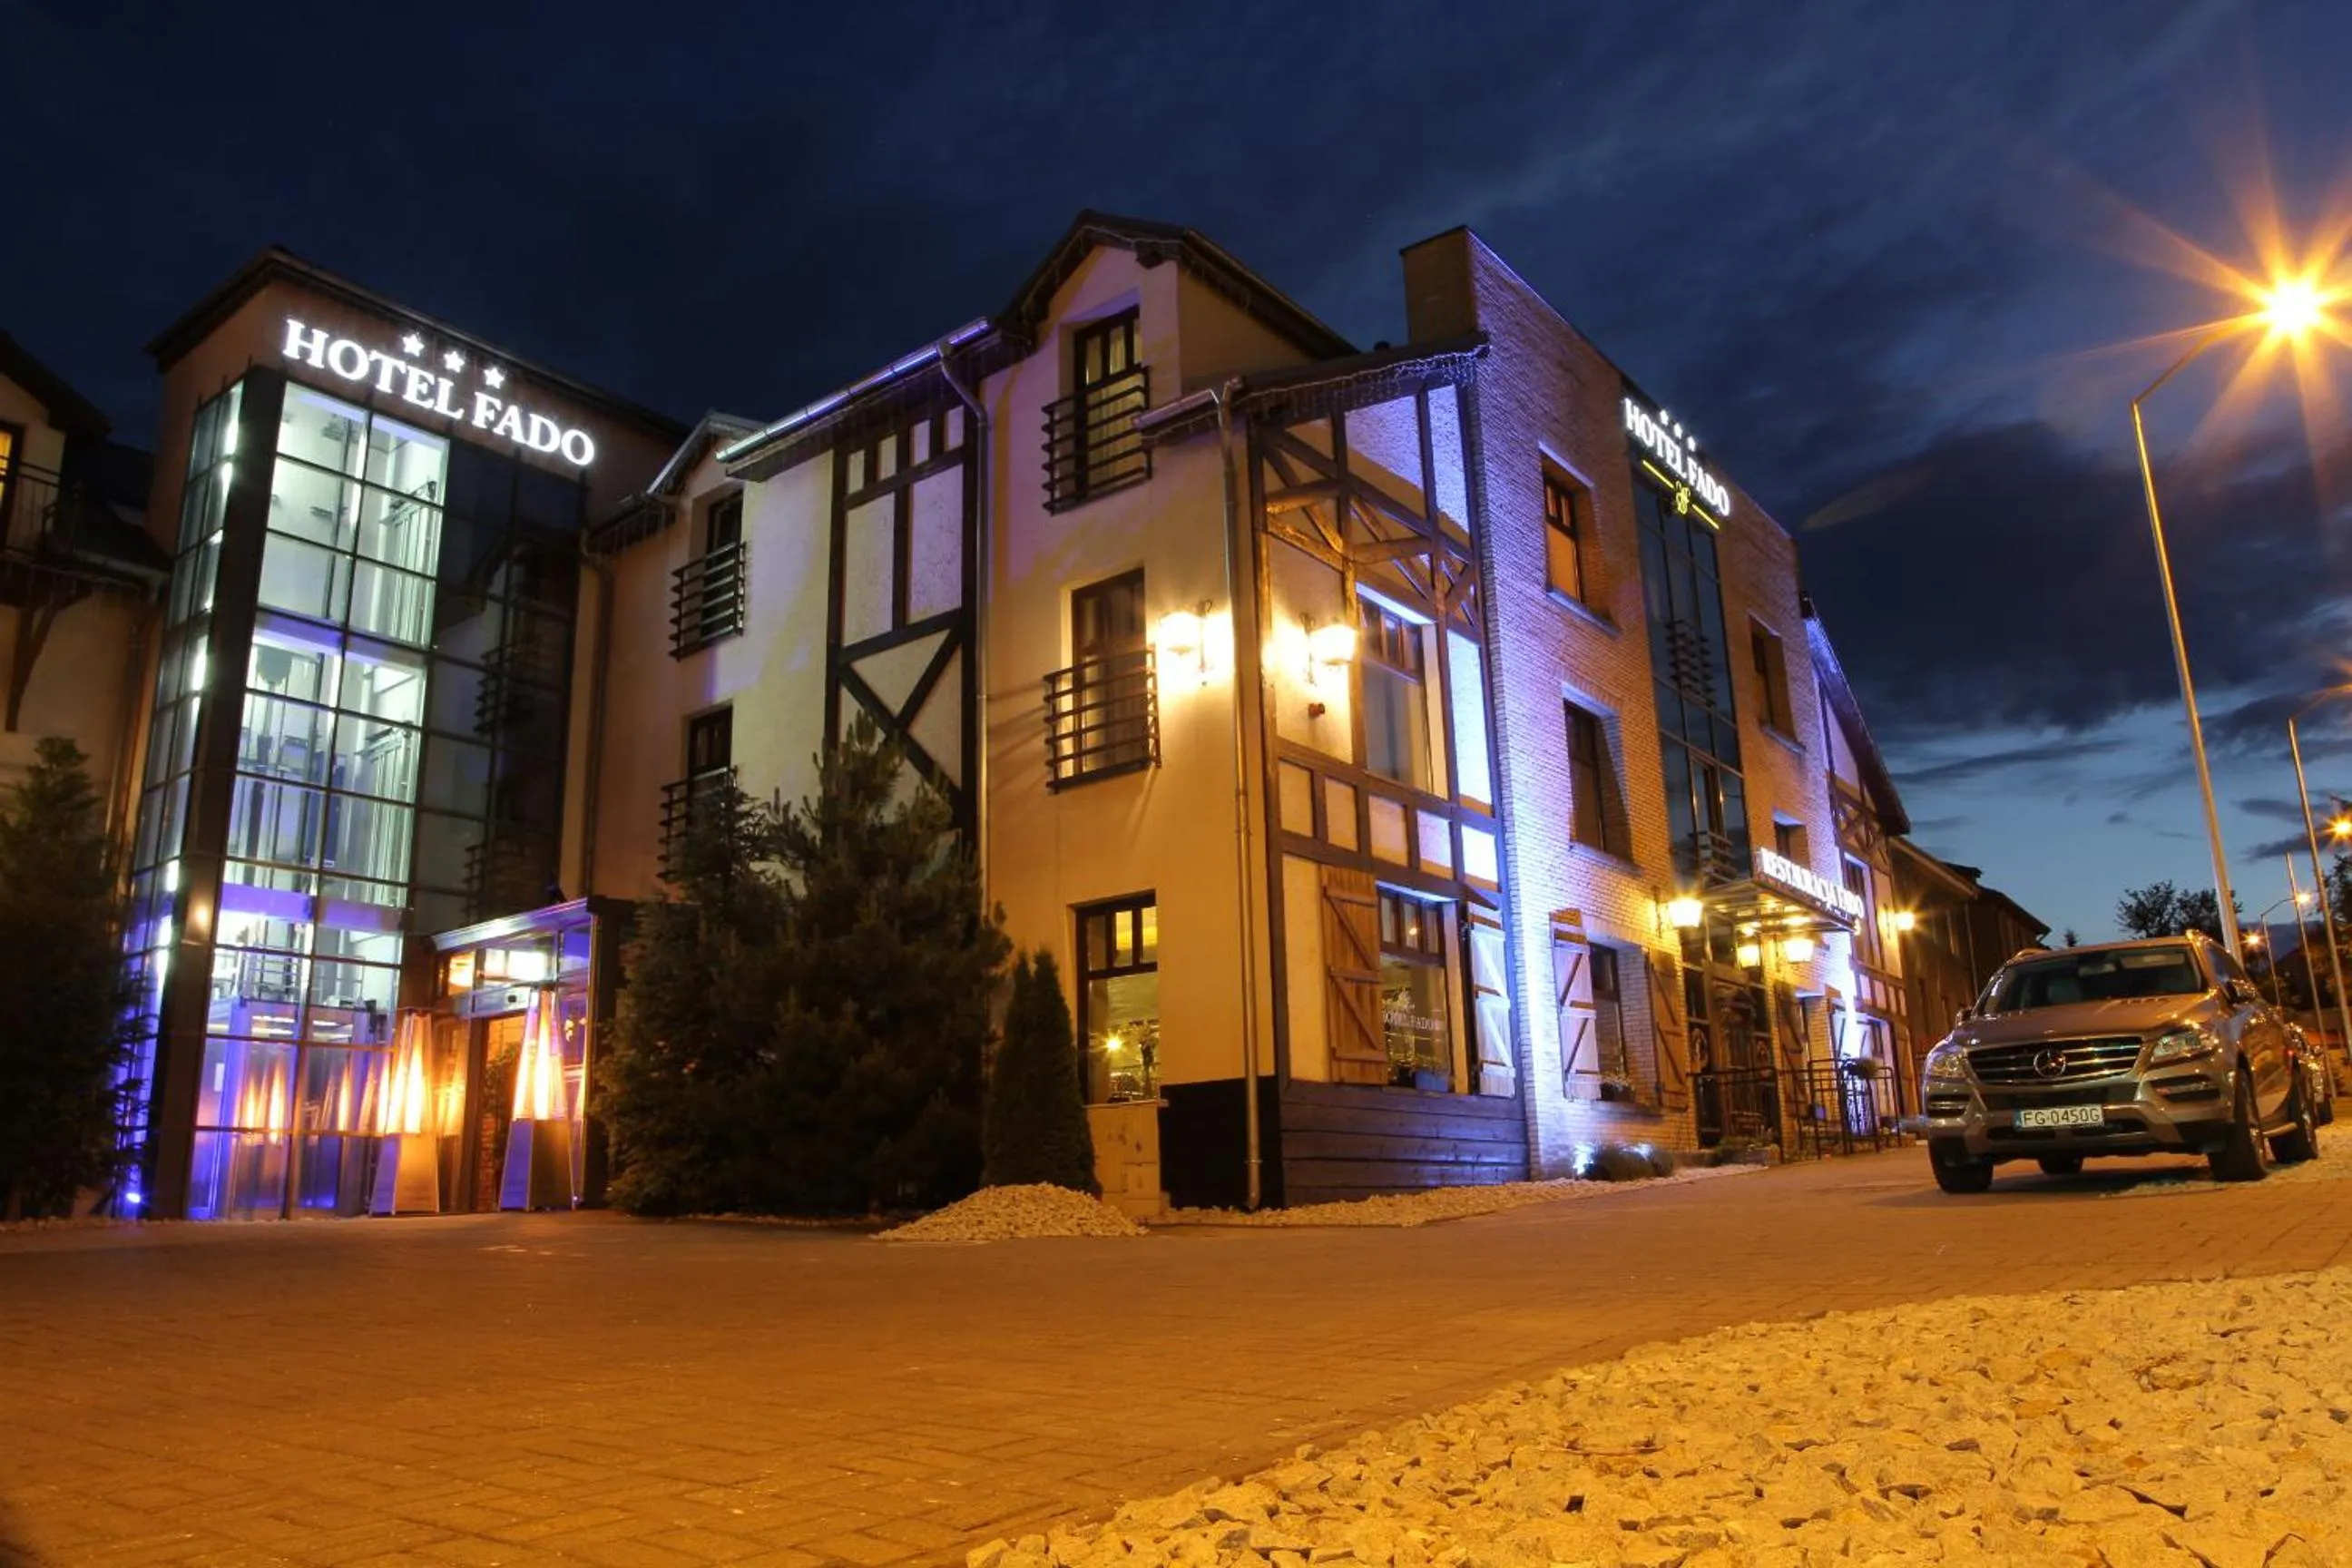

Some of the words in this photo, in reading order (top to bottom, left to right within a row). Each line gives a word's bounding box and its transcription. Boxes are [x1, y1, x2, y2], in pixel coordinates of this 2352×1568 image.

[282, 318, 465, 420] HOTEL
[472, 391, 595, 466] FADO
[1624, 397, 1687, 479] HOTEL
[1687, 456, 1730, 516] FADO
[2023, 1110, 2046, 1125] FG
